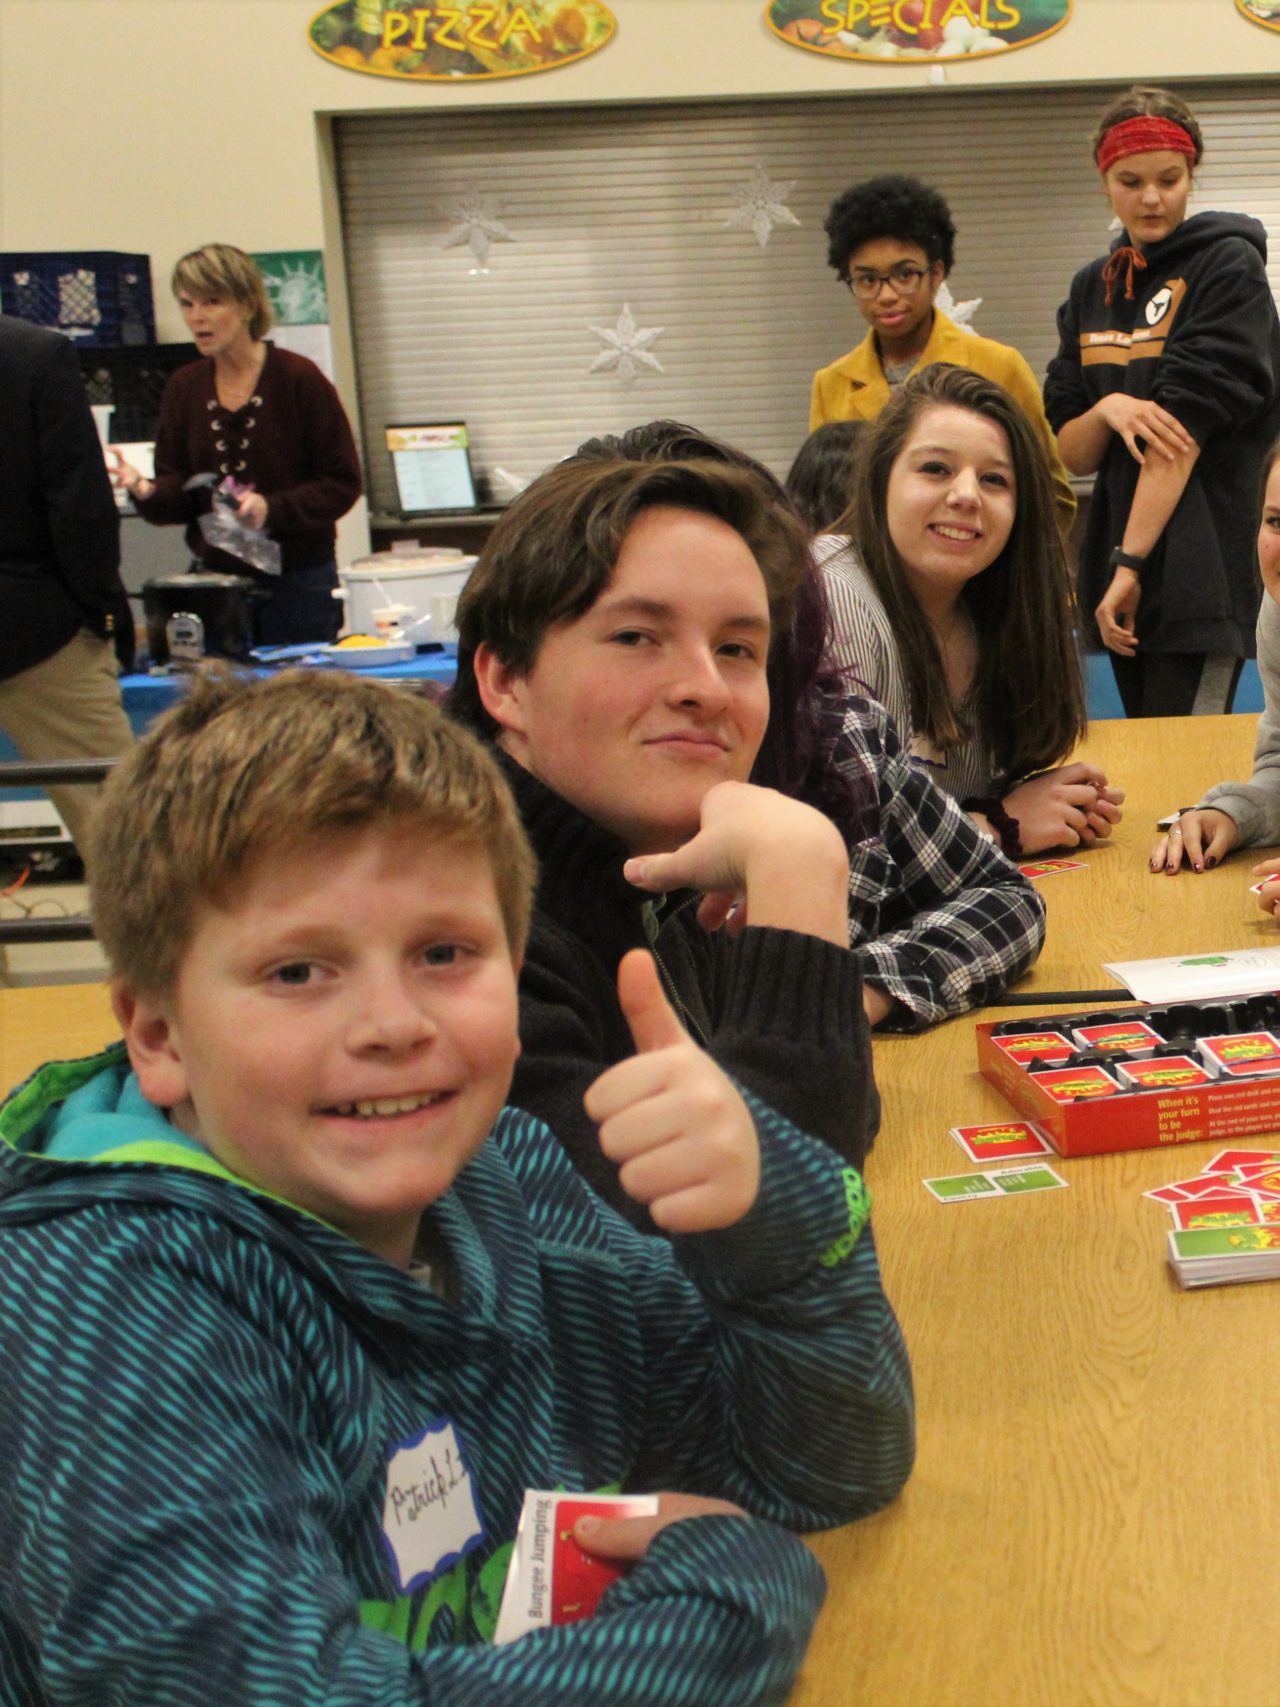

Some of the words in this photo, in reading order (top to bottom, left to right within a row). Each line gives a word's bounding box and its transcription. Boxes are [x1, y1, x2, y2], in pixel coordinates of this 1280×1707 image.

[382, 6, 543, 51] PIZZA
[820, 0, 1021, 35] SPECIALS
[1158, 1098, 1183, 1108] When
[1185, 1096, 1199, 1105] it's
[1159, 1111, 1178, 1121] your
[1181, 1108, 1200, 1117] turn
[1159, 1122, 1168, 1130] to
[1170, 1120, 1181, 1129] be
[1159, 1132, 1174, 1142] the
[390, 1456, 447, 1527] Patrick
[531, 1498, 553, 1563] Jumping
[528, 1565, 547, 1620] Bungee
